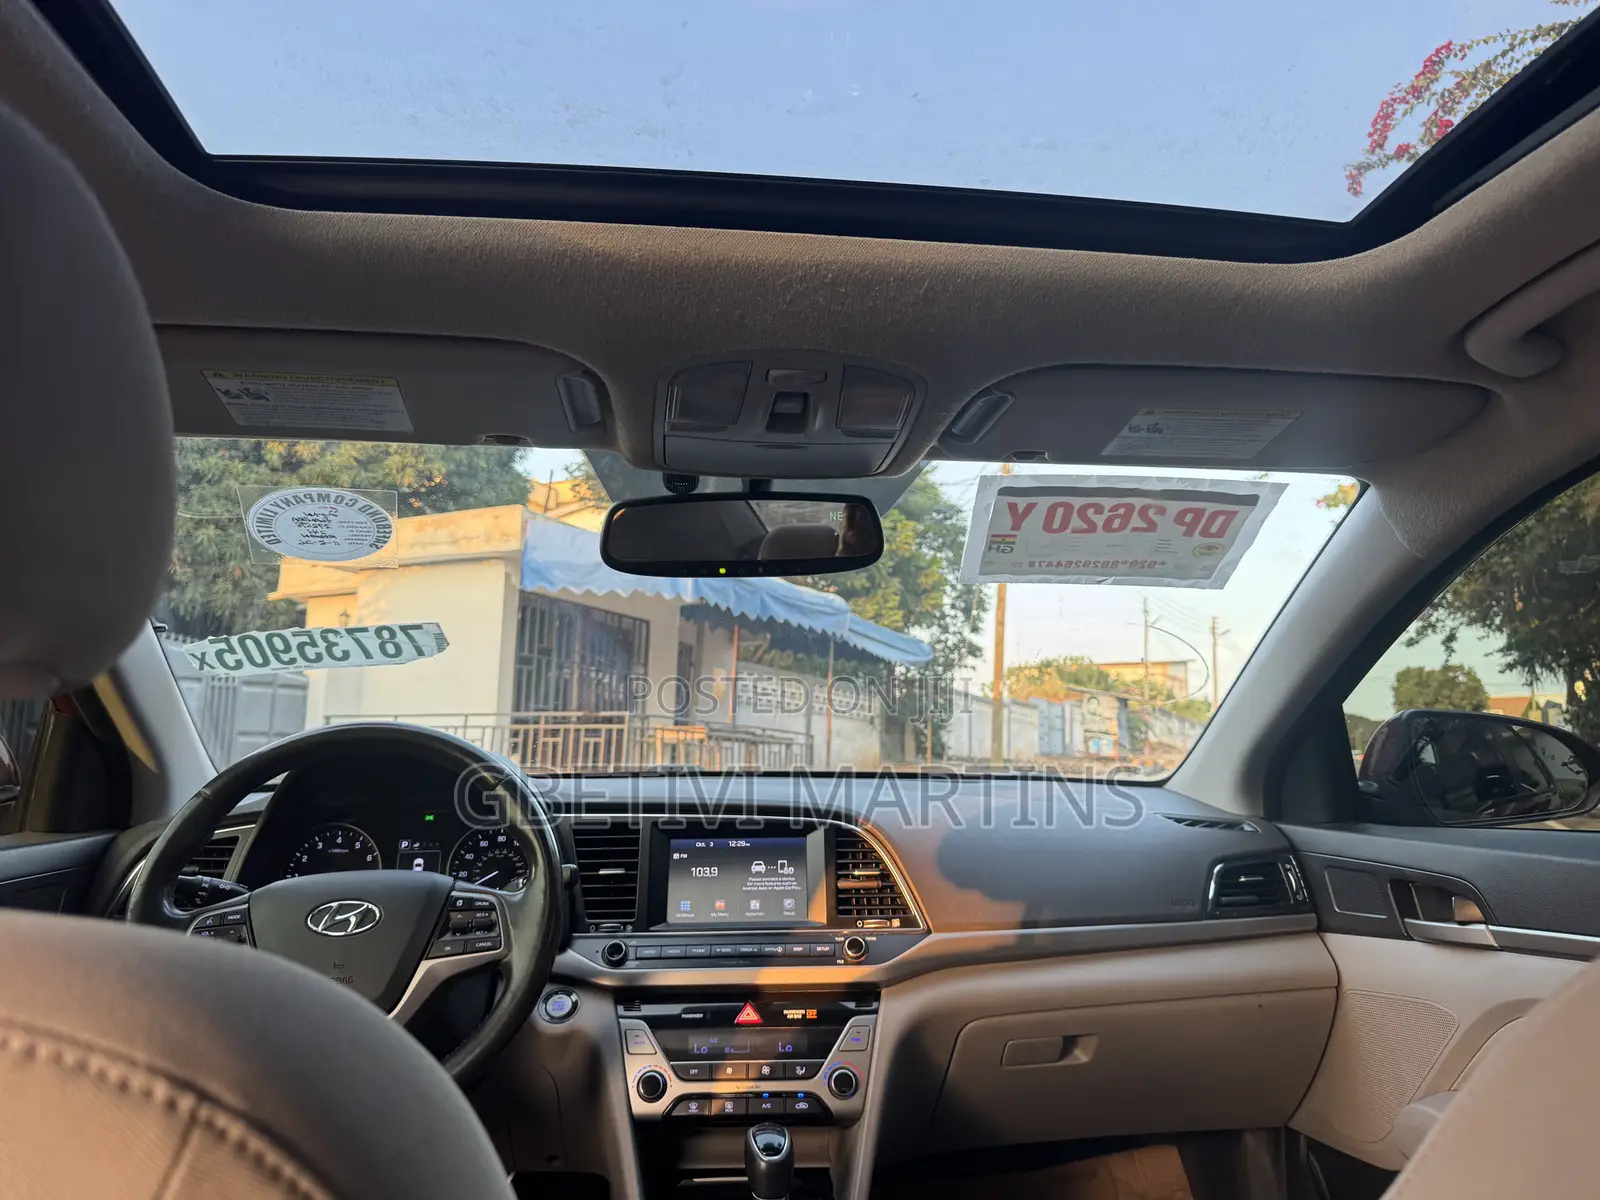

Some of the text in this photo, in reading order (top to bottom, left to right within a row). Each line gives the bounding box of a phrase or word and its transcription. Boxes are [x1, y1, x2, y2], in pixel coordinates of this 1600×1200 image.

[829, 511, 843, 521] NE
[316, 841, 323, 849] 3
[354, 841, 361, 849] 5
[401, 840, 409, 848] P
[301, 855, 308, 863] 2
[366, 854, 373, 862] 6
[690, 867, 718, 877] 103.9
